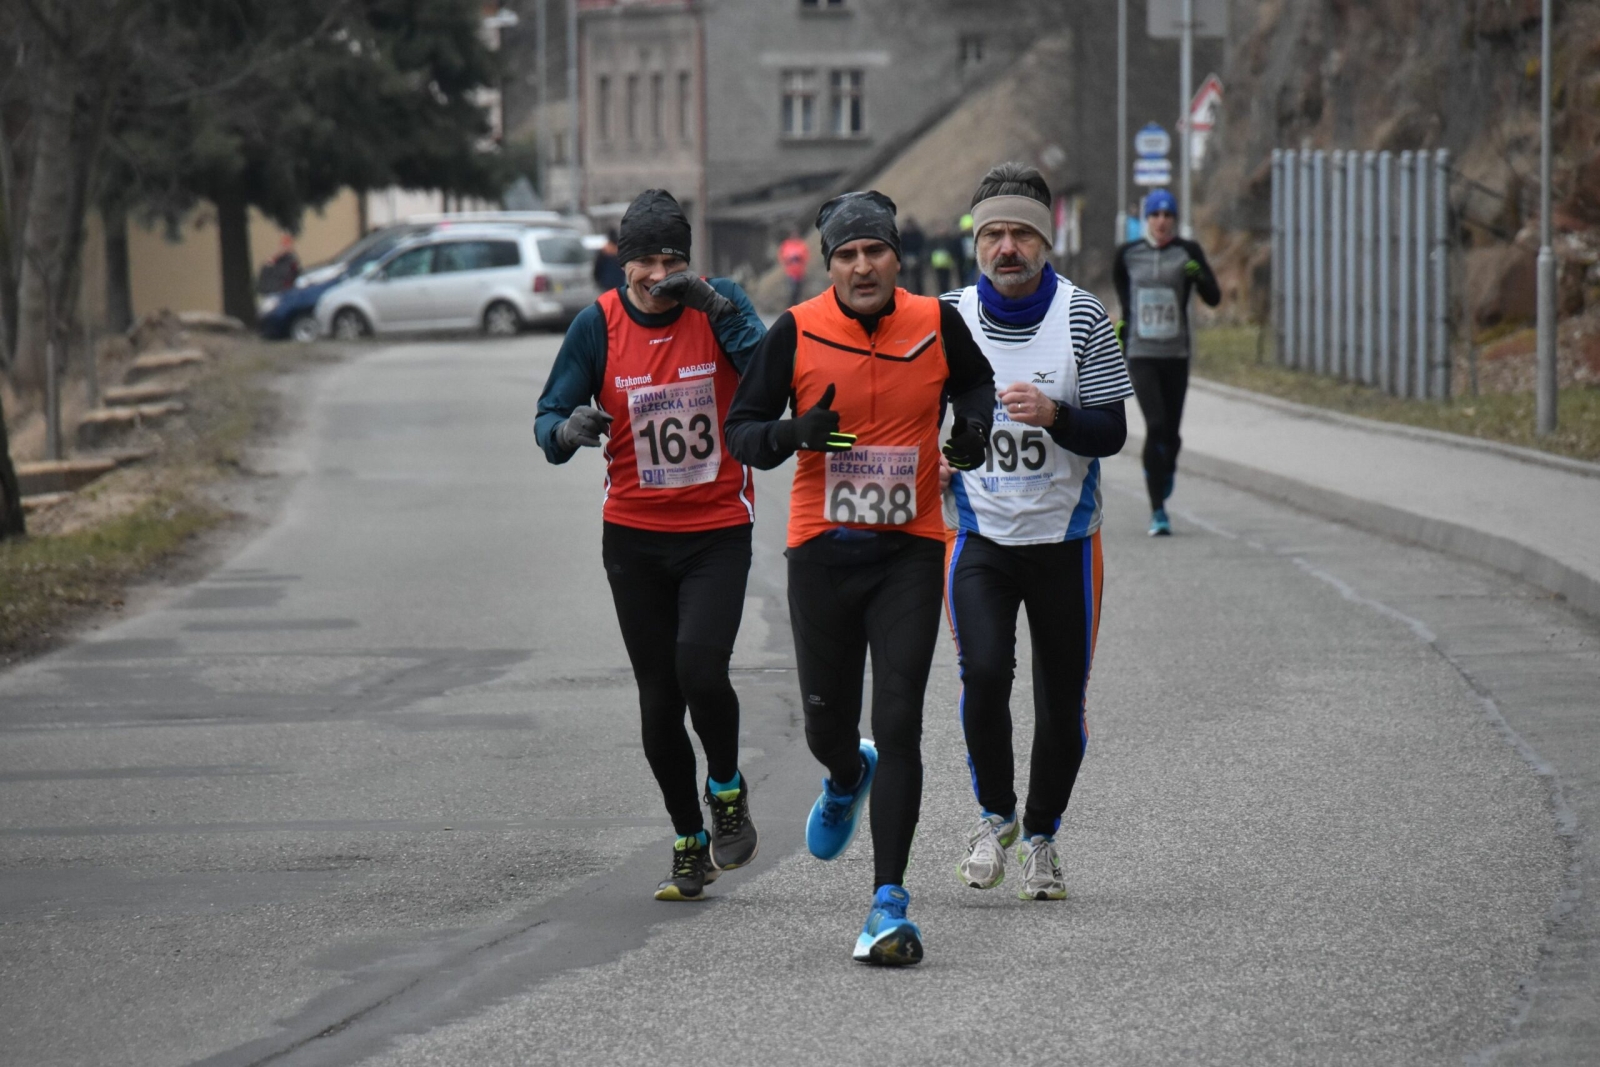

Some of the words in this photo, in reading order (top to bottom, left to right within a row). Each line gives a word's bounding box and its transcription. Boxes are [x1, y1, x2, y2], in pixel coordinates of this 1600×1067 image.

[678, 362, 716, 374] MARATON
[615, 373, 652, 388] Krakonoš
[632, 389, 667, 405] ZIMNÍ
[633, 396, 684, 415] BĚŽECKÁ
[688, 395, 714, 408] LIGA
[639, 413, 714, 465] 163
[830, 450, 868, 462] ZIMNÍ
[986, 429, 1046, 472] 195
[830, 463, 885, 475] BĚŽECKÁ
[890, 465, 914, 476] LIGA
[829, 481, 913, 525] 638
